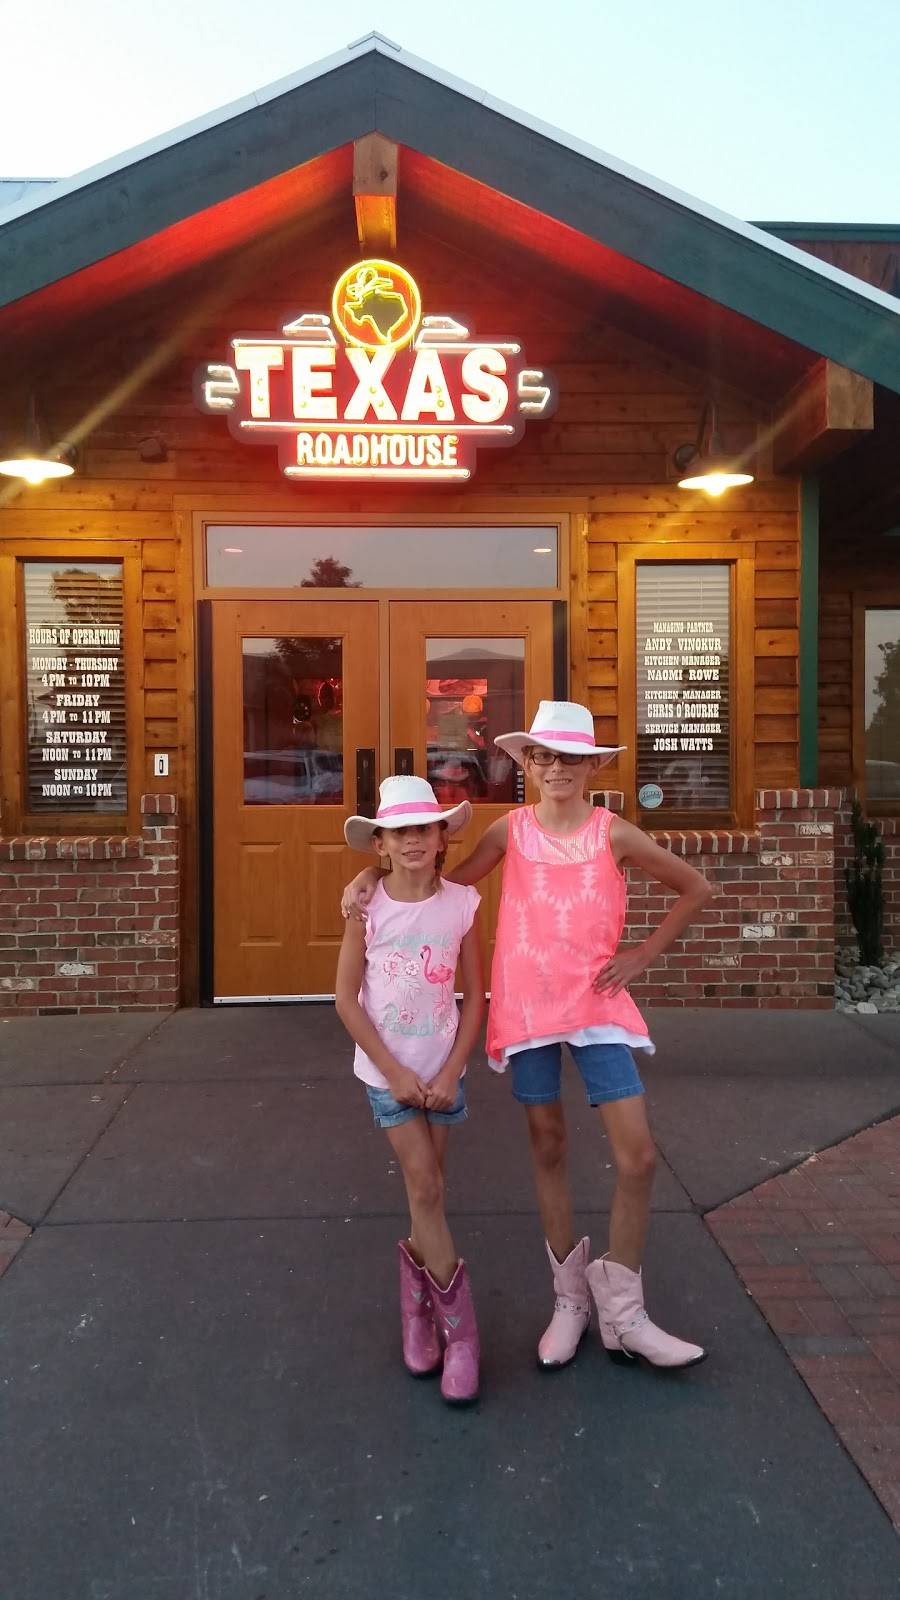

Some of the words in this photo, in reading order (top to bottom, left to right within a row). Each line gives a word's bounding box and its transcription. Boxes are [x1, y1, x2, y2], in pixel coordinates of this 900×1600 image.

[235, 347, 509, 422] TEXAS
[297, 432, 458, 465] ROADHOUSE
[654, 622, 684, 633] MANAGING
[687, 622, 713, 633] PARTNER
[29, 629, 57, 644] HOURS
[60, 629, 70, 644] OF
[73, 629, 120, 644] OPERATION
[645, 638, 672, 651] ANDY
[678, 638, 721, 651] VINOKUR
[32, 658, 67, 670] MONDAY
[75, 658, 118, 670] THURSDAY
[644, 656, 679, 665] KITCHEN
[682, 656, 720, 665] MANAGER
[42, 674, 65, 687] 4PM
[81, 674, 110, 687] 10PM
[648, 670, 682, 680] NAOMI
[689, 670, 719, 680] ROWE
[56, 695, 99, 706] FRIDAY
[645, 691, 679, 699] KITCHEN
[683, 691, 721, 699] MANAGER
[648, 704, 673, 718] CHRIS
[677, 702, 719, 718] O'ROURKE
[42, 711, 66, 723] 4PM
[83, 711, 110, 723] 11PM
[645, 724, 679, 734] SERVICE
[681, 724, 721, 734] MANAGER
[46, 732, 107, 743] SATURDAY
[653, 738, 677, 751] JOSH
[680, 738, 713, 751] WATTS
[42, 748, 68, 761] NOON
[85, 748, 111, 760] 11PM
[55, 769, 97, 780] SUNDAY
[42, 785, 70, 796] NOON
[86, 784, 112, 797] 10PM
